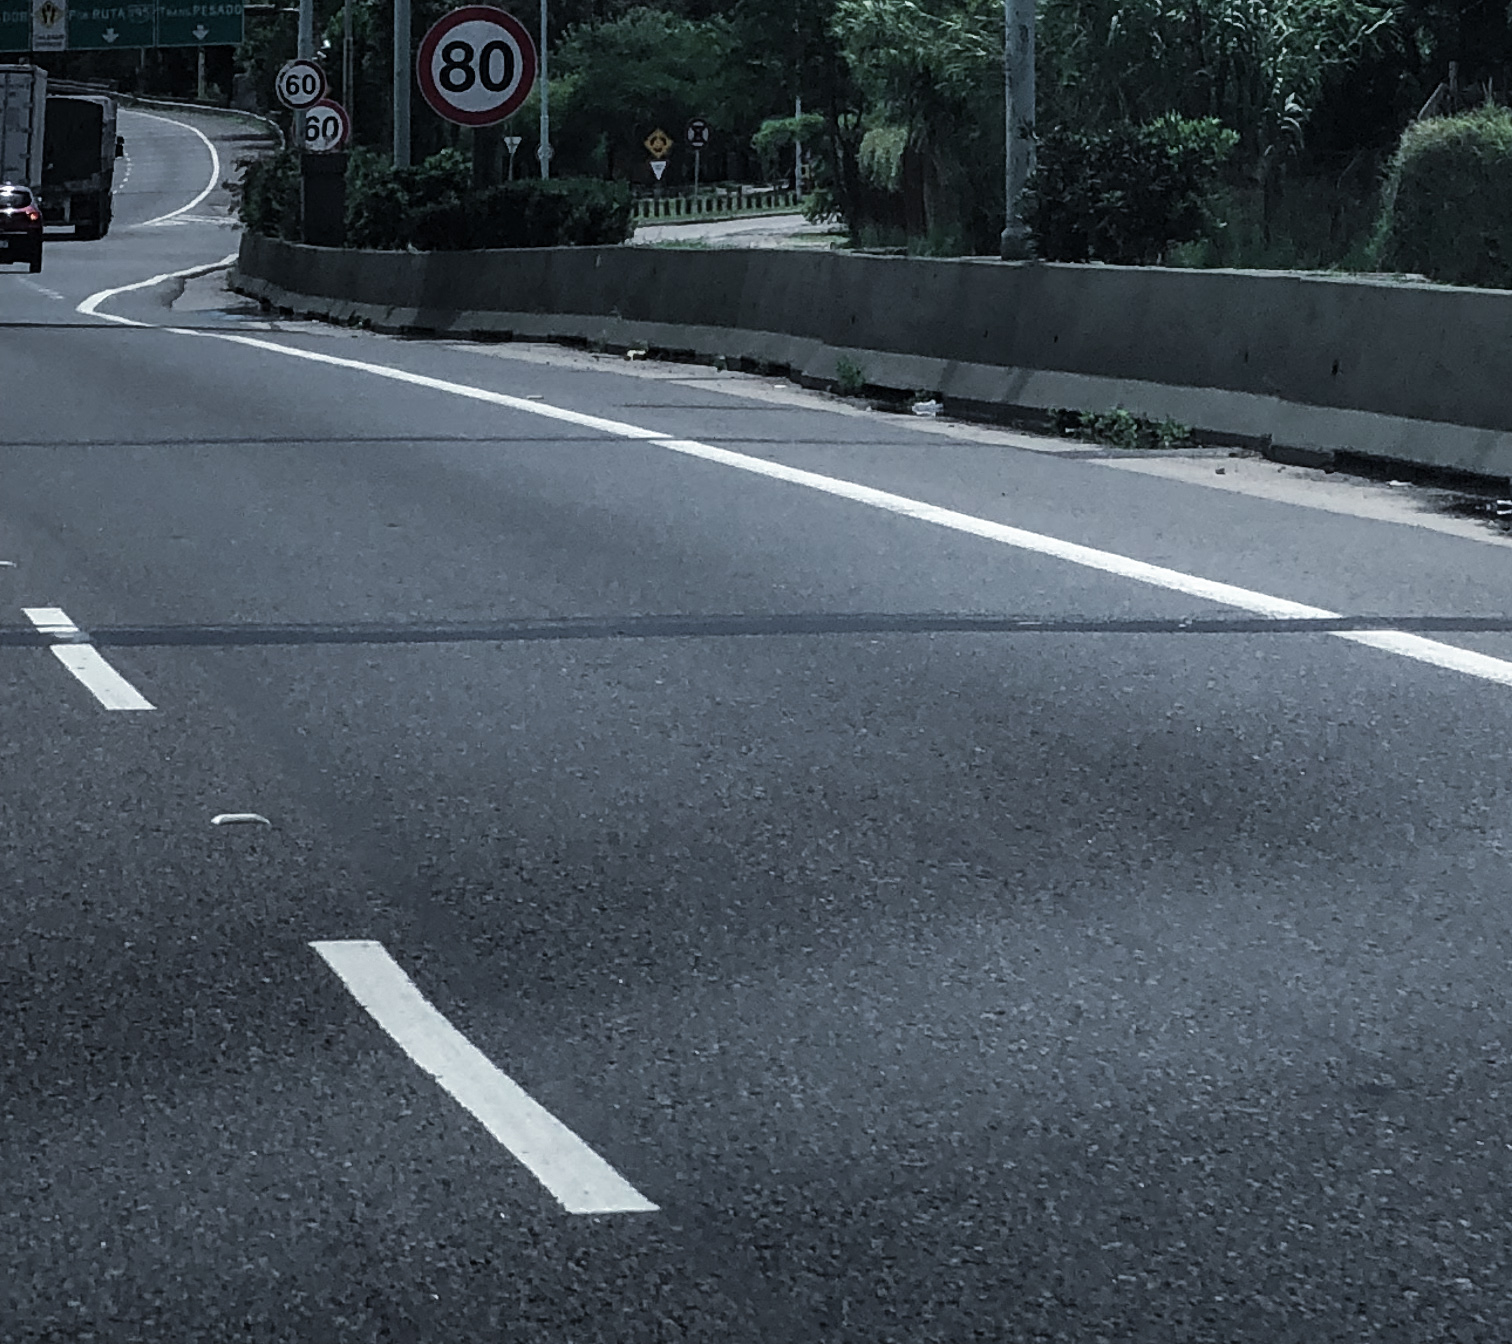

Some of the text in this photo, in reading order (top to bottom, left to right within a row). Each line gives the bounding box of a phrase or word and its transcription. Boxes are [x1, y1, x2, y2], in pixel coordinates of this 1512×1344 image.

[438, 39, 515, 93] 80
[284, 73, 316, 96] 60
[304, 115, 339, 143] 60
